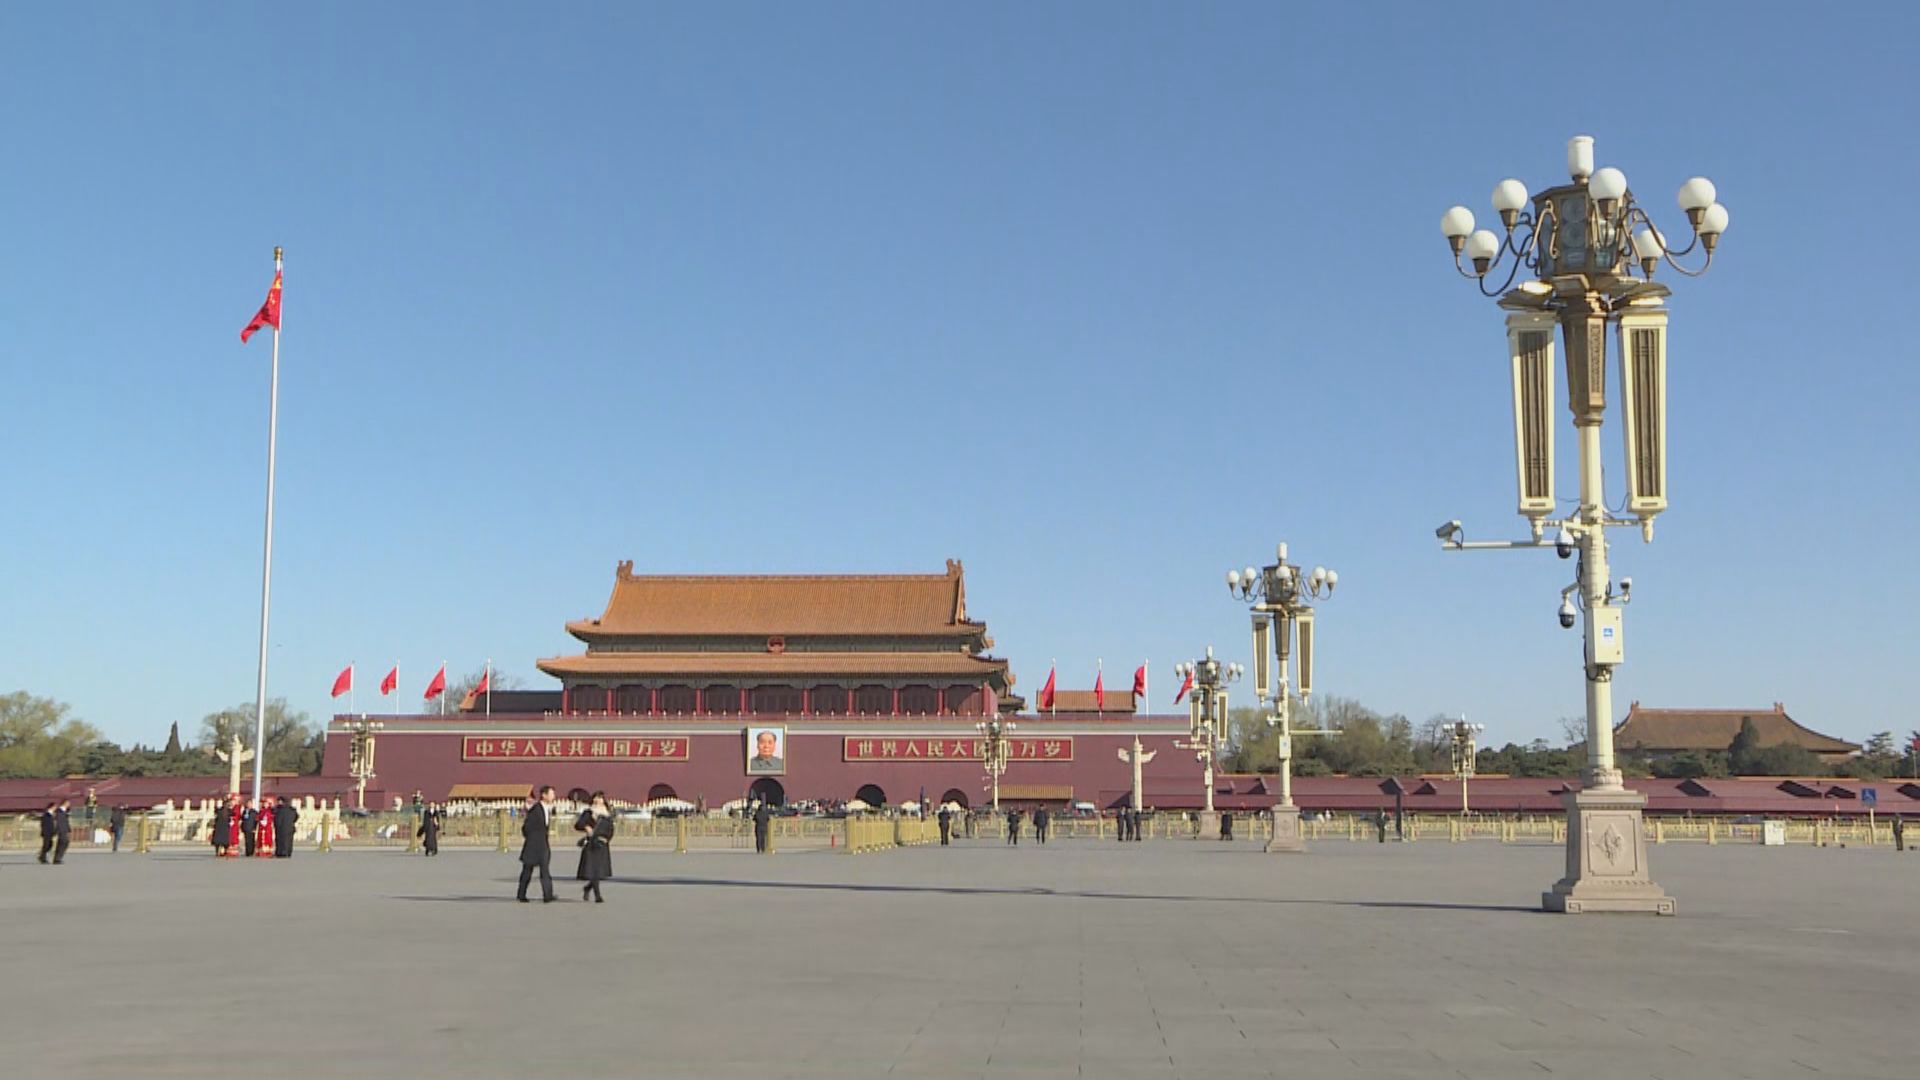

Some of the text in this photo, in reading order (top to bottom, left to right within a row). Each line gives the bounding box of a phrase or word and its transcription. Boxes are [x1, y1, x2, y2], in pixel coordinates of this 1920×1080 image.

[475, 739, 678, 756] 中华人民共和国万岁
